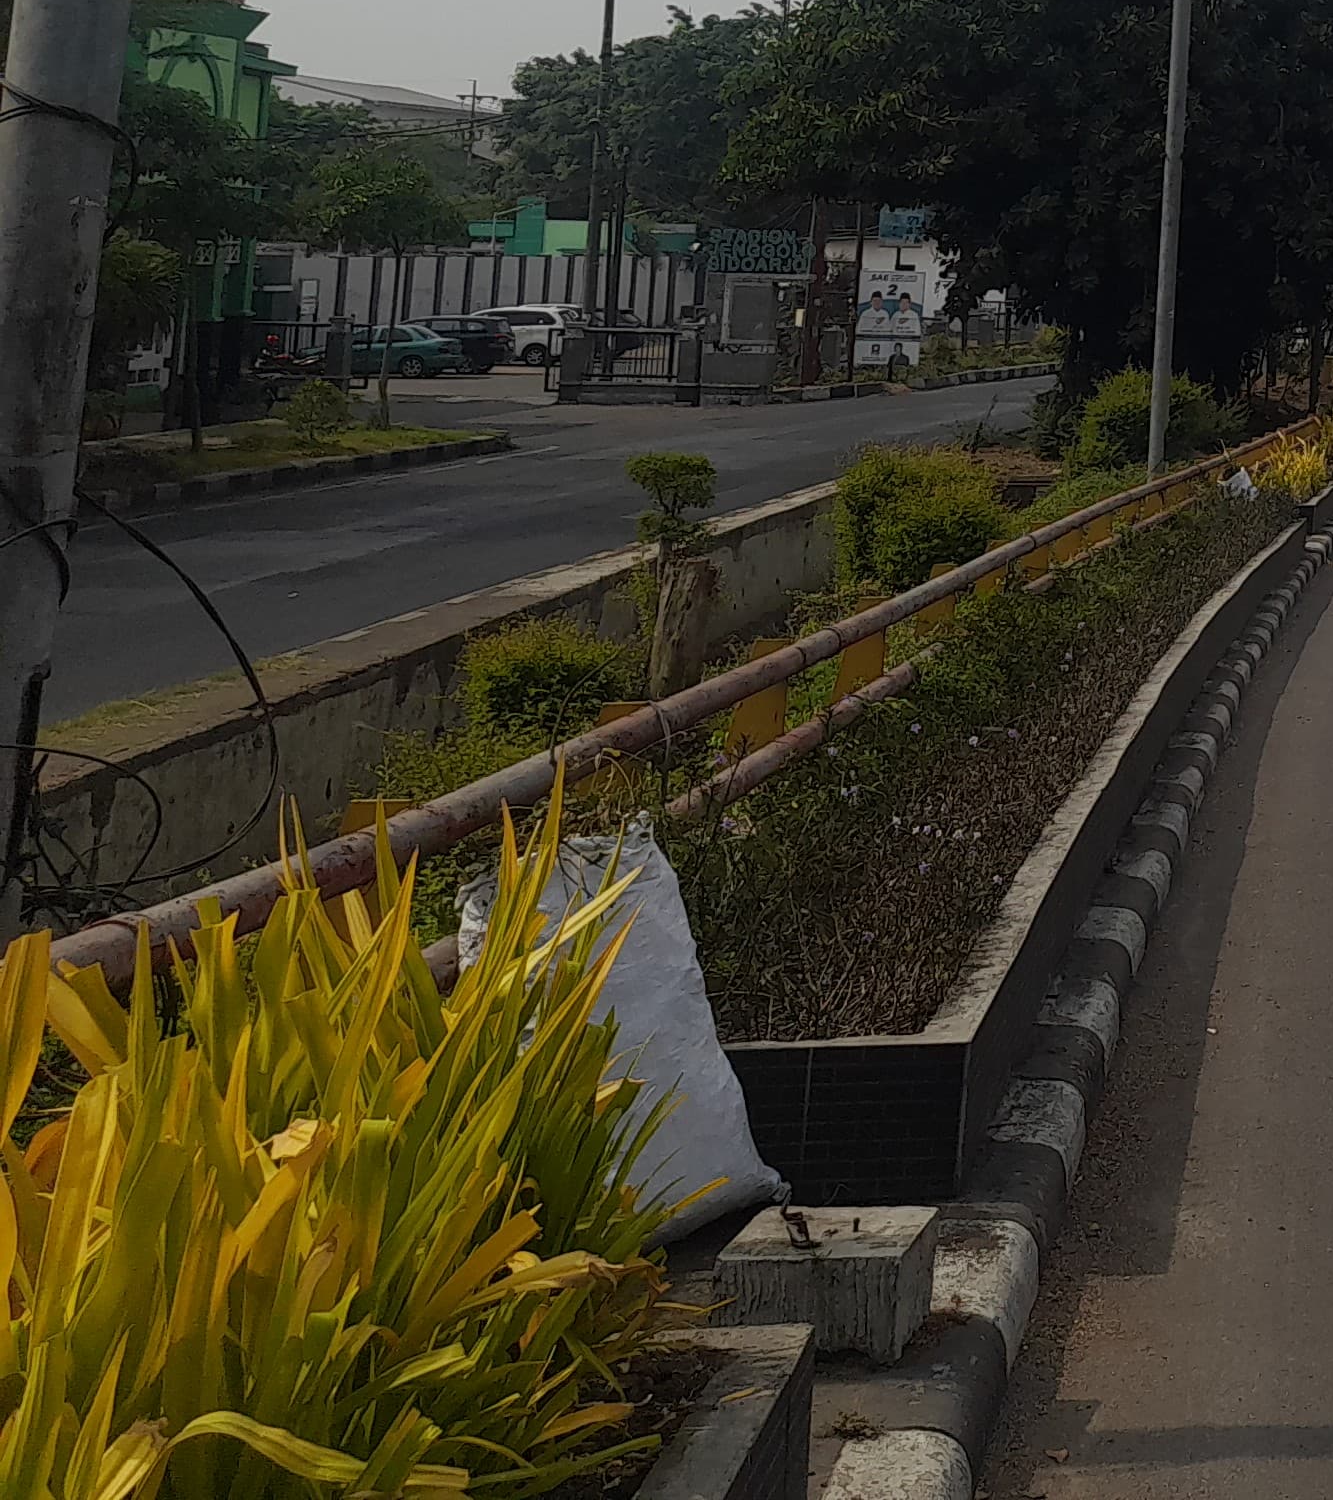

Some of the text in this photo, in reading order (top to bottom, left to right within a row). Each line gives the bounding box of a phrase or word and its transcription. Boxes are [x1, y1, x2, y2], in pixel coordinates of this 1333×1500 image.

[709, 228, 797, 244] STADION
[709, 243, 817, 260] JENGGOLO
[707, 257, 809, 272] SIDOARJO
[886, 284, 898, 296] 2
